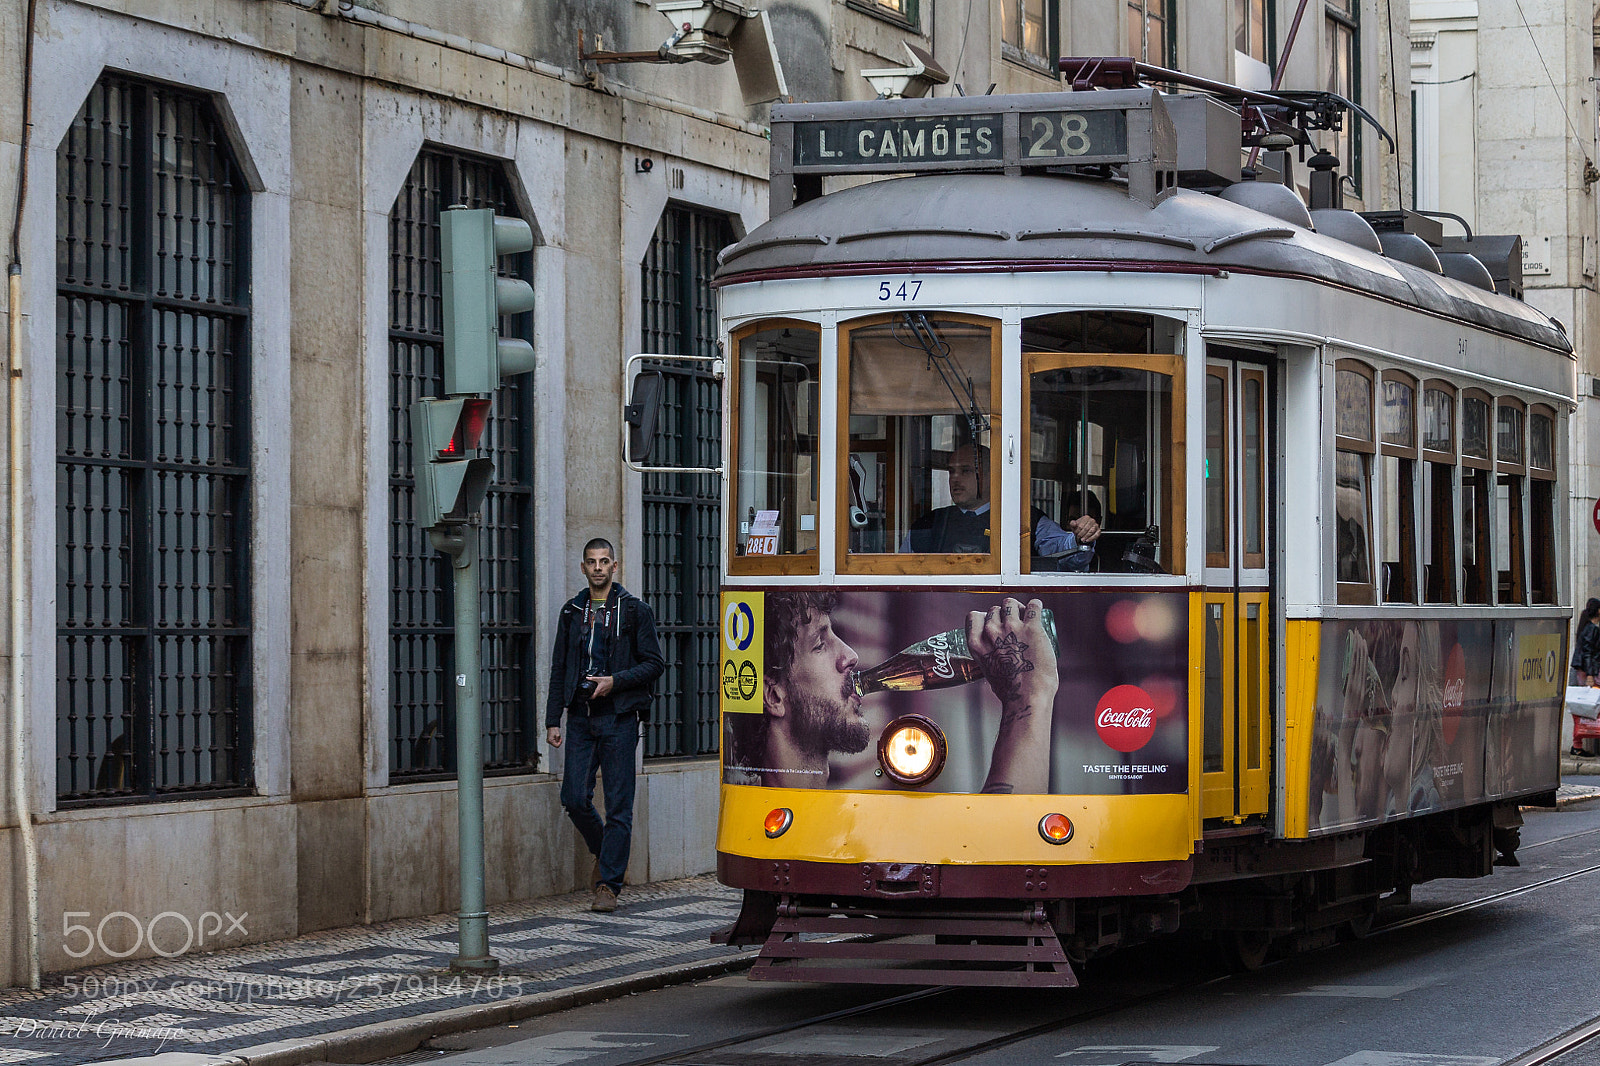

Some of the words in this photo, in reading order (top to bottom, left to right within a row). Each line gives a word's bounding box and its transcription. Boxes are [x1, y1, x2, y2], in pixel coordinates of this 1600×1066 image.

[819, 130, 843, 158] L.
[858, 124, 992, 158] CAMÕES
[1029, 113, 1091, 157] 28
[879, 280, 923, 301] 547
[1459, 337, 1468, 356] 547
[747, 537, 764, 554] 28E
[766, 538, 774, 553] 6
[1522, 648, 1543, 681] carris
[1097, 707, 1154, 728] Coca-Cola
[1082, 764, 1111, 773] TASTE
[1113, 764, 1130, 773] THE
